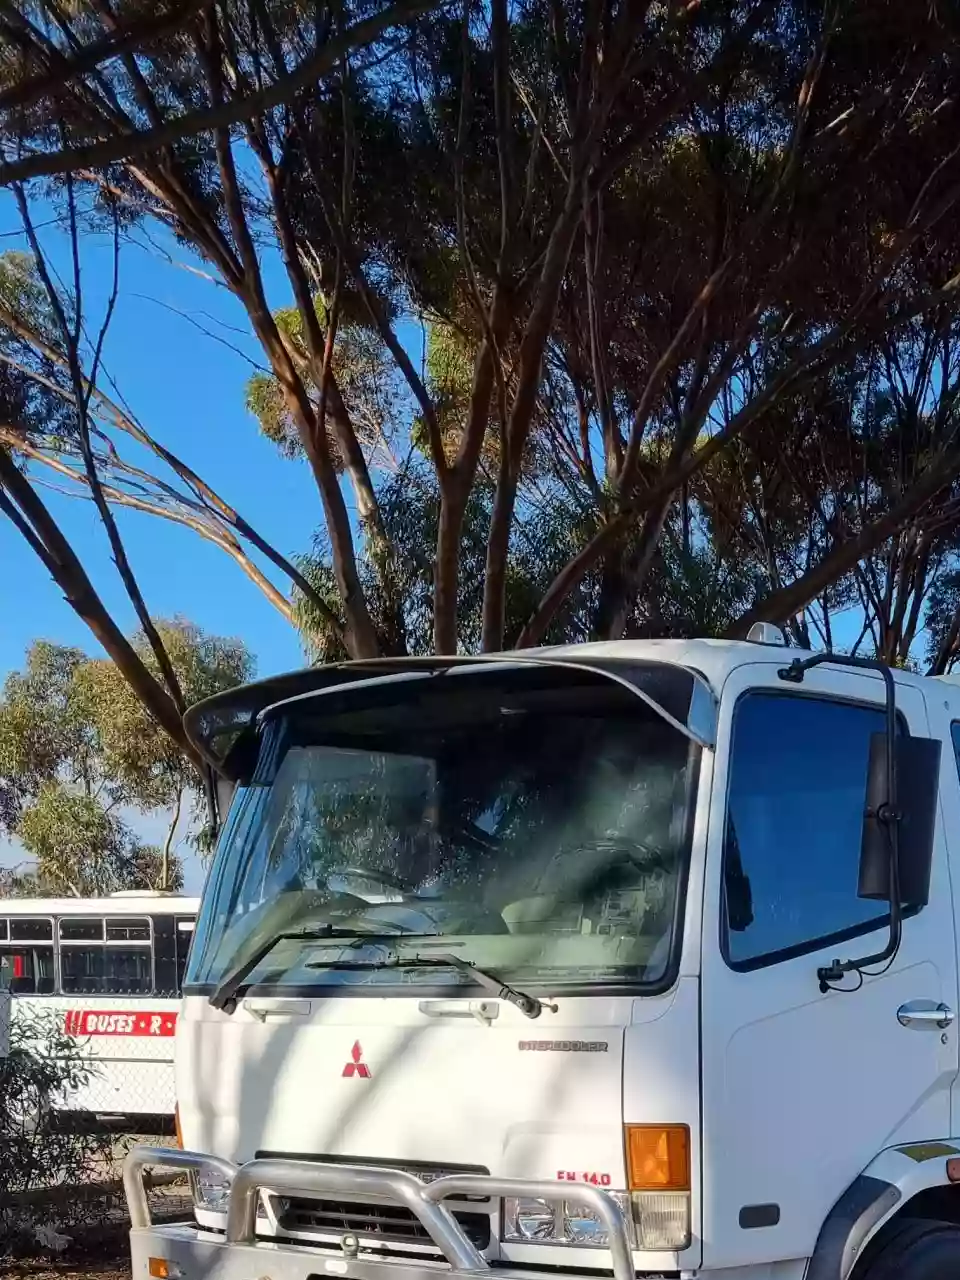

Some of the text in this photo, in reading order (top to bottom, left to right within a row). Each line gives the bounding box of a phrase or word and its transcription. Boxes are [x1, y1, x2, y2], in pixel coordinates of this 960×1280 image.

[86, 1013, 162, 1035] BUSES R
[518, 1040, 608, 1052] INTERCOOLER
